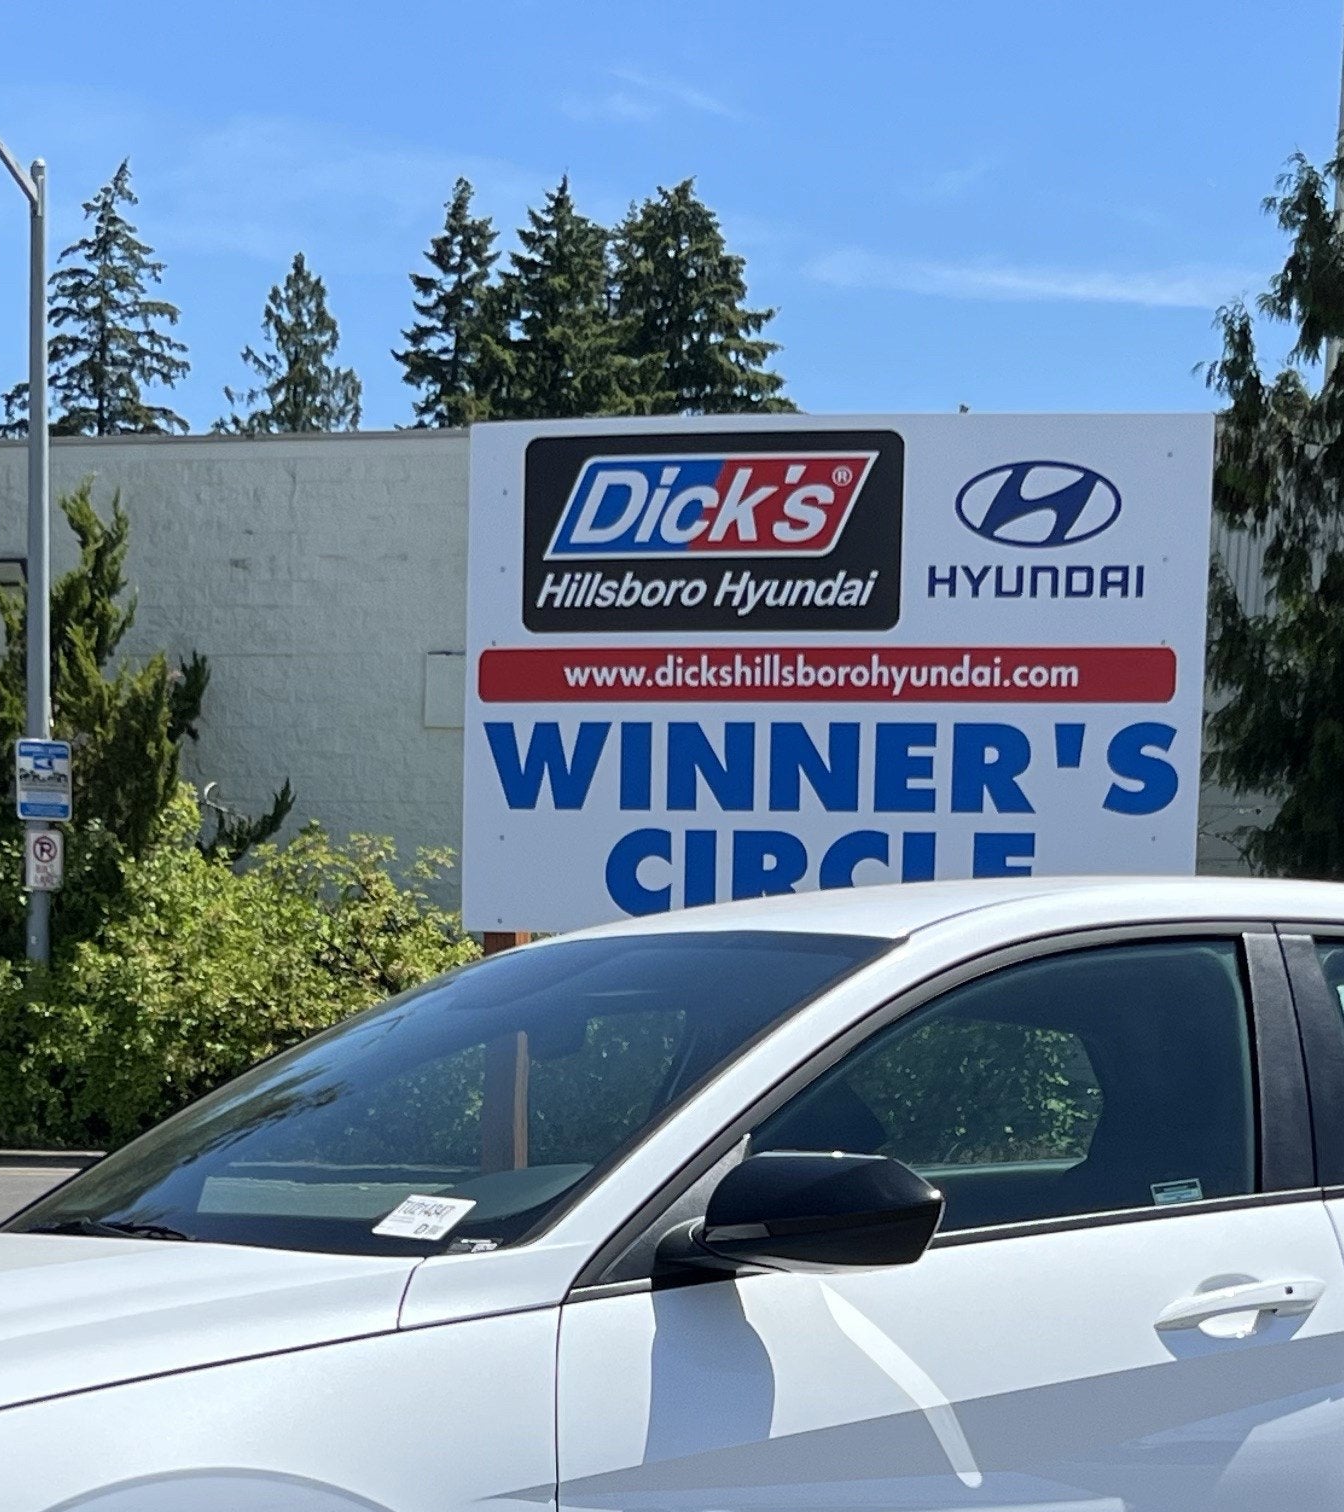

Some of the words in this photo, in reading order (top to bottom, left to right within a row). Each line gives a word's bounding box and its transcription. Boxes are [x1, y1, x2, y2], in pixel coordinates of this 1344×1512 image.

[569, 464, 835, 545] Dick's
[536, 571, 707, 609] Hillsboro
[713, 570, 879, 616] Hyundai
[927, 564, 1144, 600] HYUNDAI
[564, 653, 1079, 696] www.dickshillsborohyundai.com
[484, 721, 1179, 816] WINNER'S
